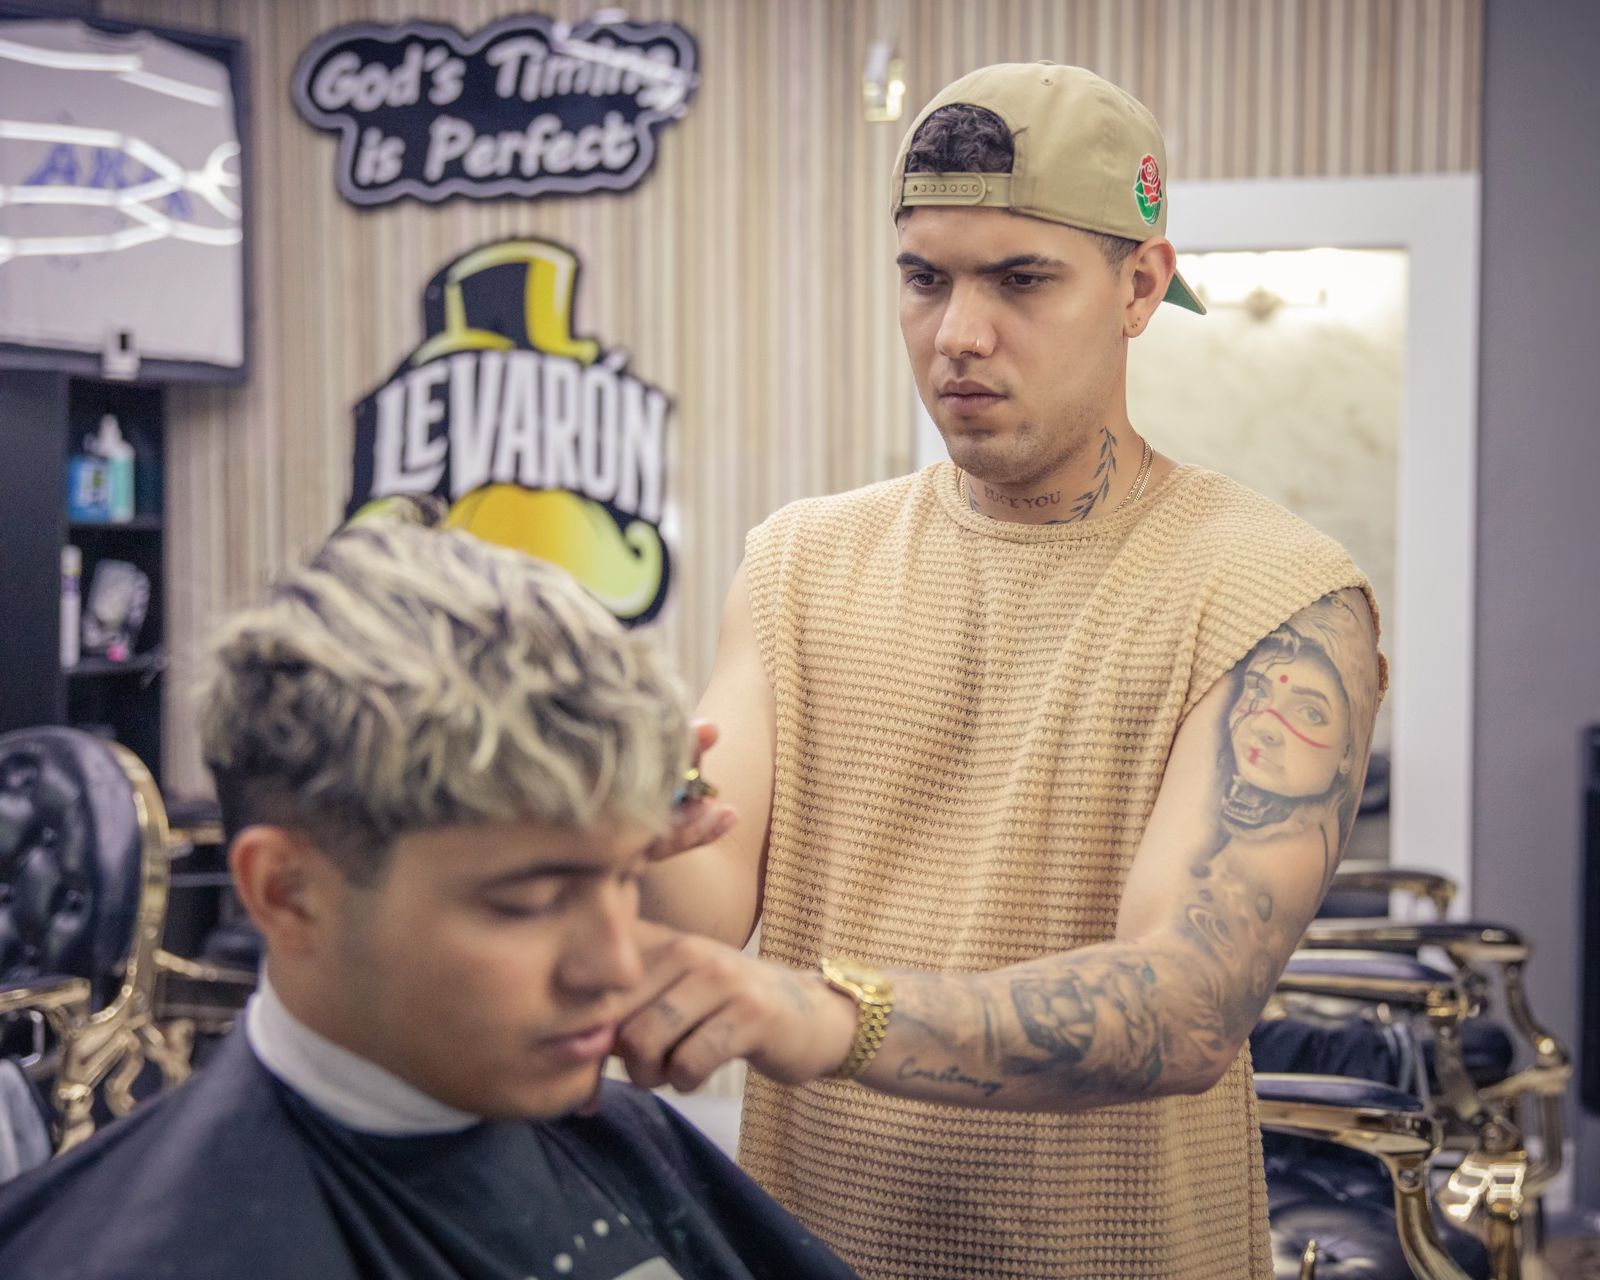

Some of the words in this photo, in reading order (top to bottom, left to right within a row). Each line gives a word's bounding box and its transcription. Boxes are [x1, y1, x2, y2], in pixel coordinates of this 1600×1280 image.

[312, 42, 466, 112] God's
[354, 126, 405, 186] is
[424, 113, 637, 182] Perfect
[1022, 490, 1061, 508] YOU
